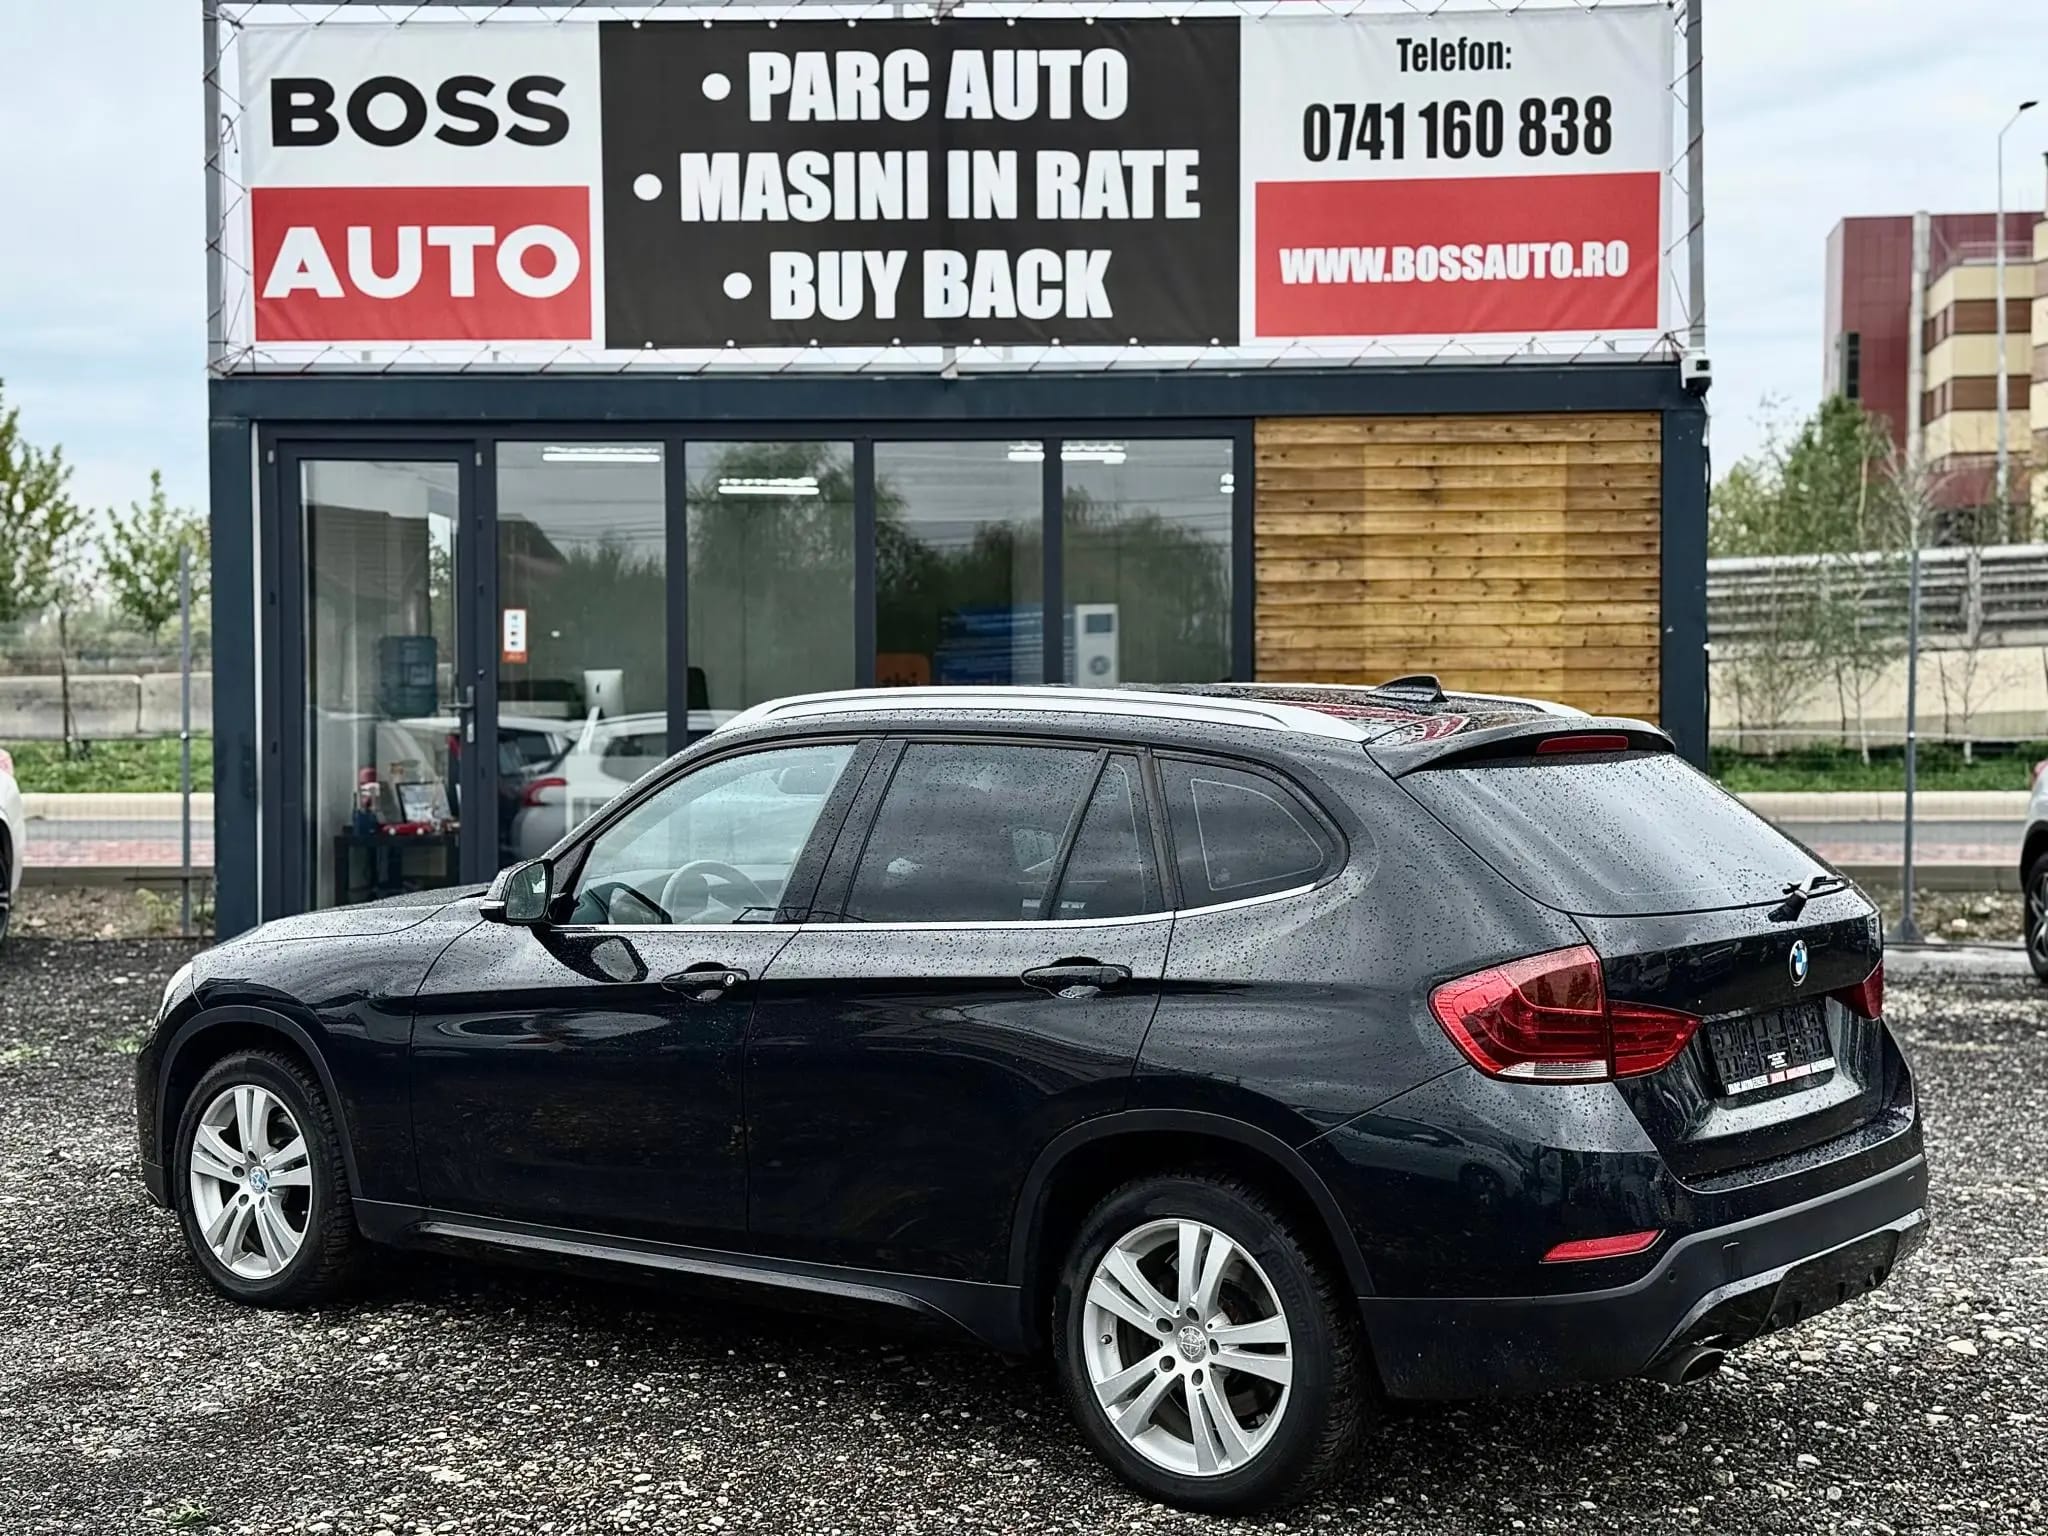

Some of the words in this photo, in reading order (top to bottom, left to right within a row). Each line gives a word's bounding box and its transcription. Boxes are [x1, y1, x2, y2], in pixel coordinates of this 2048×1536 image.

[748, 49, 930, 122] PARC
[944, 47, 1128, 121] AUTO
[1396, 38, 1512, 73] Telefon:
[271, 78, 569, 146] BOSS
[1303, 102, 1405, 162] 0741
[1418, 99, 1504, 160] 160
[1518, 95, 1612, 157] 838
[680, 150, 929, 223] MASINI
[948, 150, 1018, 220] IN
[1036, 149, 1201, 220] RATE
[262, 225, 581, 299] AUTO
[769, 250, 908, 321] BUY
[923, 249, 1114, 320] BACK
[1279, 239, 1630, 286] WWW.BOSSAUTO.RO
